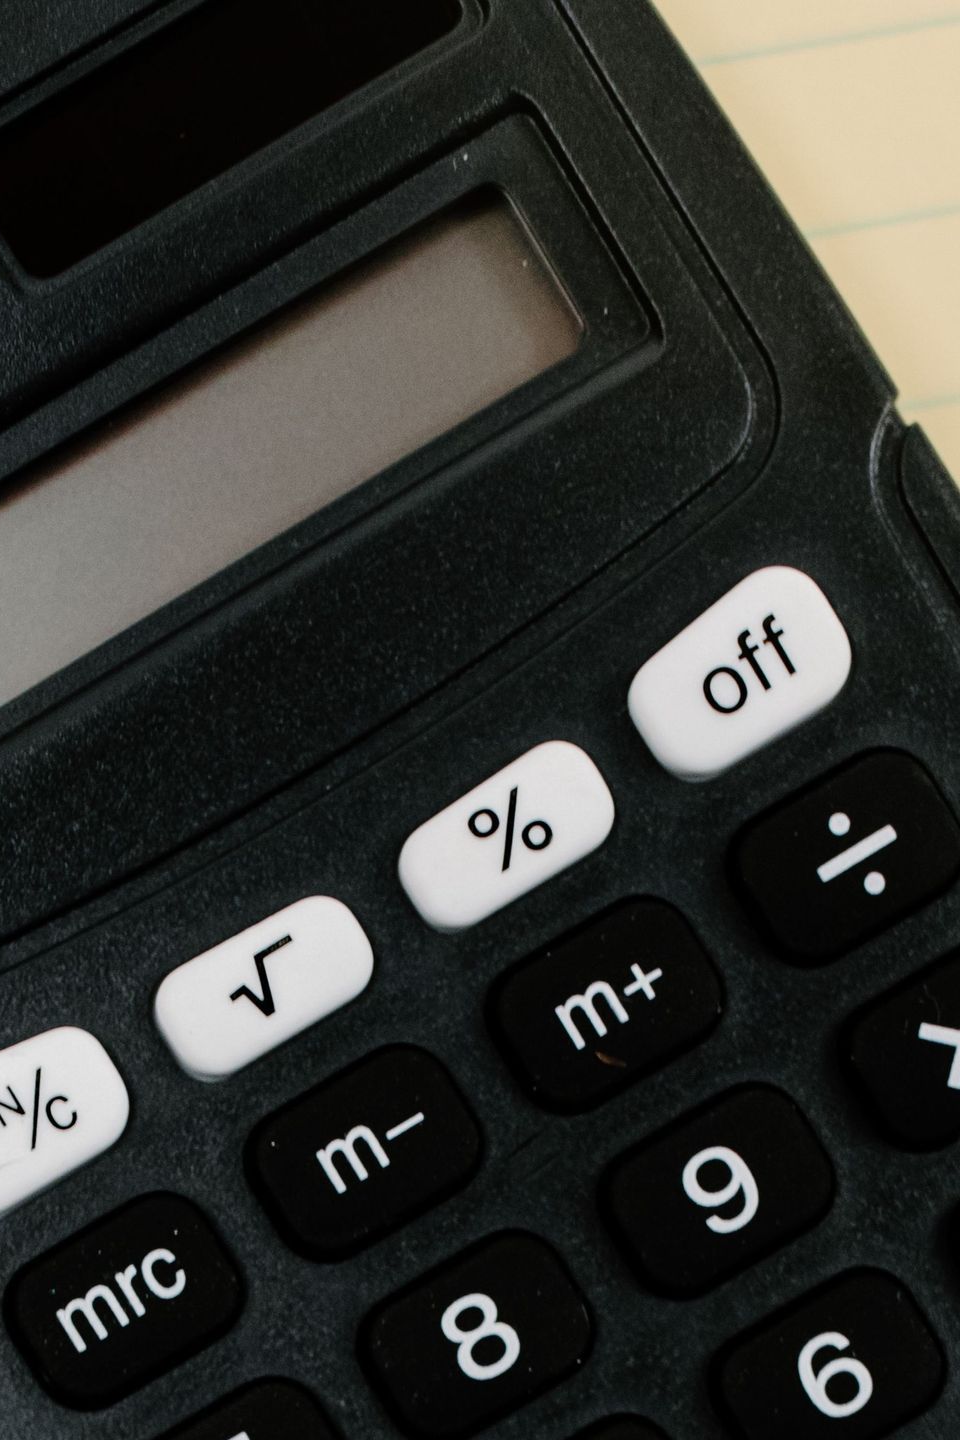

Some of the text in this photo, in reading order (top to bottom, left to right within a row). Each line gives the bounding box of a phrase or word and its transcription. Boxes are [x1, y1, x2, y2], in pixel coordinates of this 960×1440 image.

[701, 612, 800, 716] off
[466, 786, 555, 873] %
[554, 963, 663, 1050] m+
[316, 1112, 425, 1194] m-
[682, 1146, 759, 1234] 9
[56, 1248, 186, 1353] mrc
[441, 1293, 521, 1380] 8
[797, 1331, 873, 1418] 6
